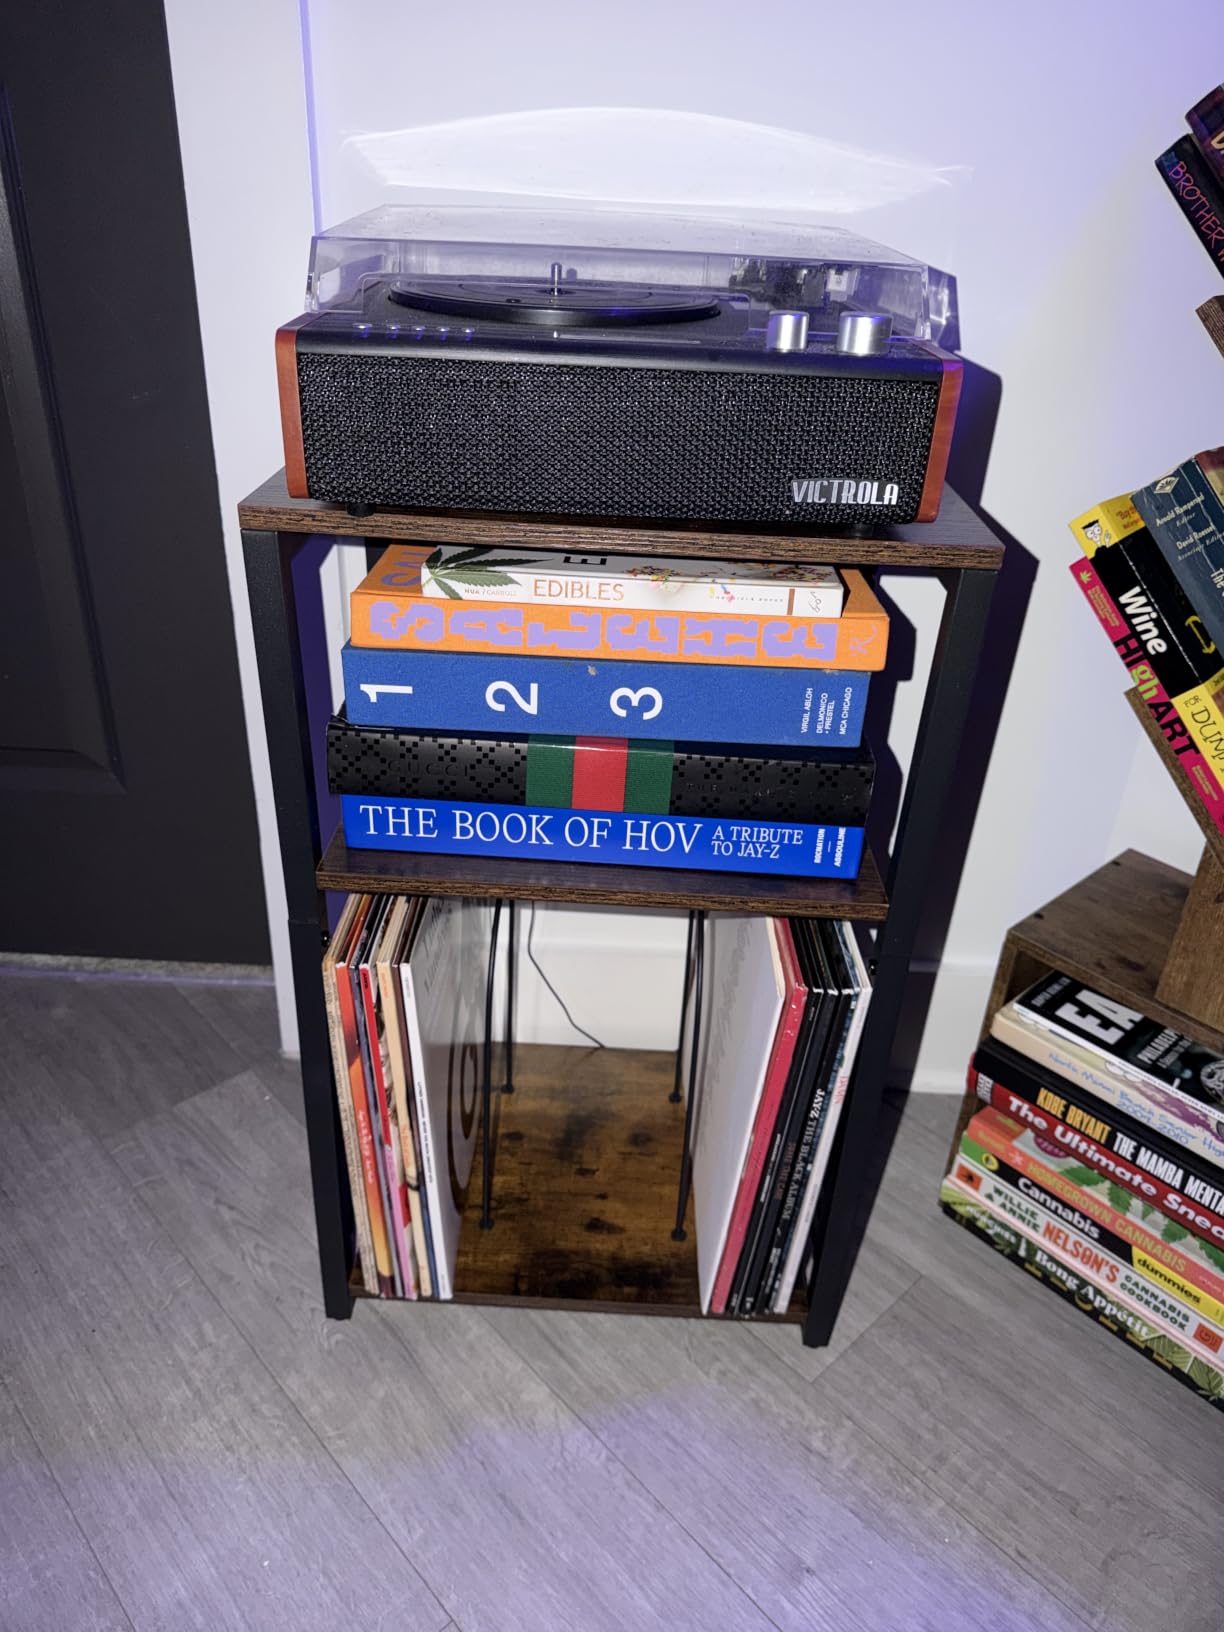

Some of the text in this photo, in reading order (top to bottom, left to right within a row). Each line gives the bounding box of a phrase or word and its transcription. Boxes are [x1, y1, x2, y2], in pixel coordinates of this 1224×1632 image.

[792, 480, 899, 505] VICTROLA
[533, 579, 625, 602] EDIBLES
[1118, 585, 1168, 655] Wine
[359, 681, 663, 721] 1 2 3
[801, 687, 813, 733] VIRGIL ABLOH
[816, 693, 828, 734] DELMONICO
[825, 700, 835, 731] PRESTEL
[839, 687, 852, 735] MCA CHICAGO
[1148, 701, 1200, 758] ART
[359, 805, 703, 854] THE BOOK OF HOV
[711, 841, 781, 859] TO JAY-Z
[712, 826, 804, 845] A TRIBUTE
[834, 827, 847, 867] ASSOULINE
[803, 1118, 817, 1143] THE
[1009, 1096, 1048, 1130] The
[1054, 1125, 1158, 1197] Ultimate
[1036, 1087, 1068, 1120] KOBE
[1065, 1104, 1111, 1144] BRYANT
[1112, 1132, 1139, 1161] THE
[1135, 1147, 1185, 1189] MAMBA
[791, 1143, 811, 1181] BLACK
[781, 1181, 799, 1219] ALBUM
[992, 1185, 1040, 1221] WILLIE
[999, 1201, 1042, 1233] ANNIE
[1027, 1161, 1186, 1272] HOMEGROWN CANNABIS
[1018, 1177, 1101, 1239] Cannabis
[1136, 1256, 1202, 1304] dummies
[1042, 1220, 1121, 1283] NELSON'S
[1035, 1249, 1081, 1291] Bong
[1080, 1284, 1151, 1338] Appétit
[1119, 1282, 1188, 1331] COOKBOOK
[1123, 1274, 1191, 1323] CANNABIS
